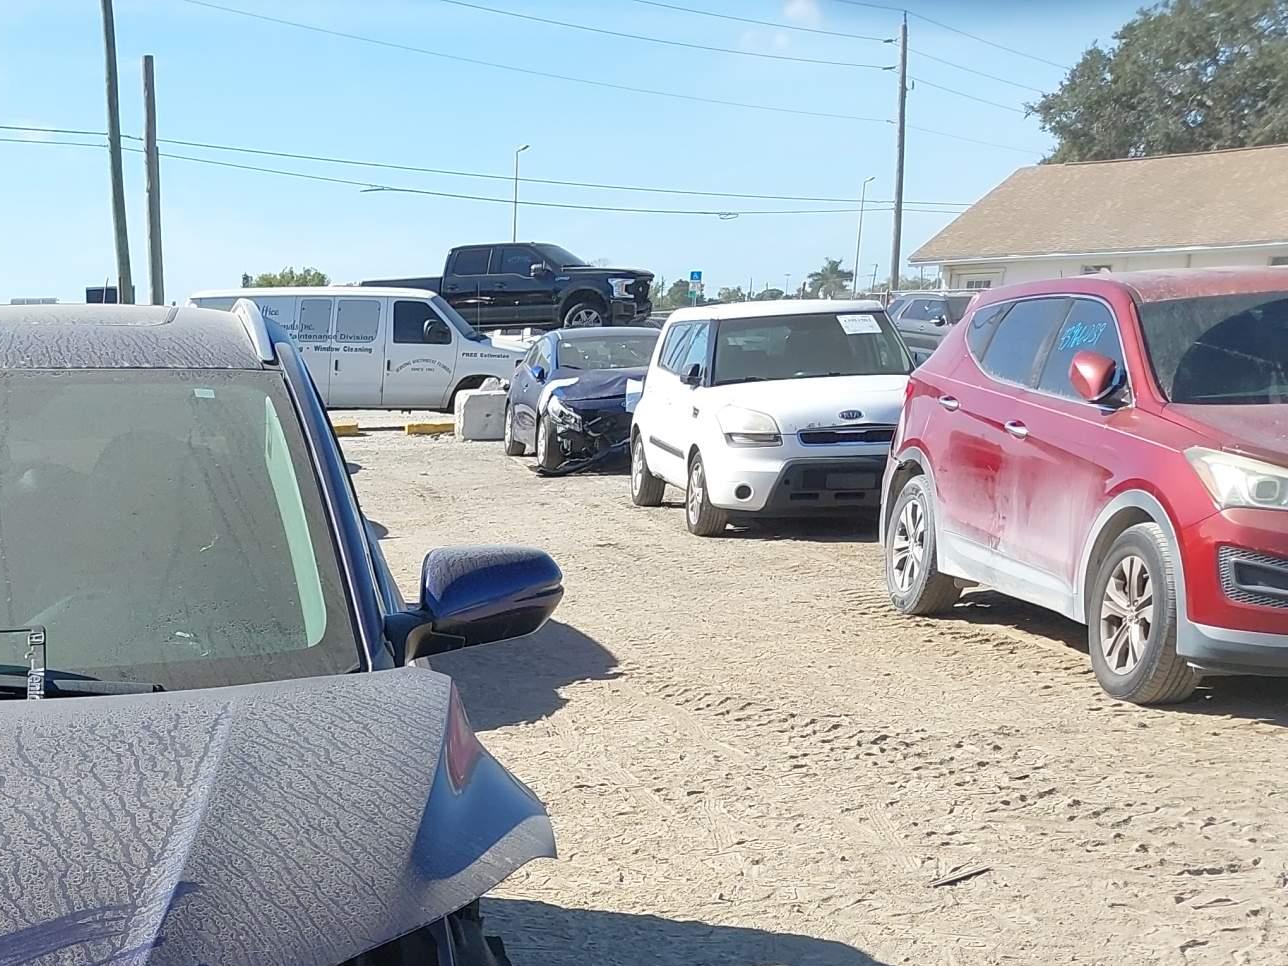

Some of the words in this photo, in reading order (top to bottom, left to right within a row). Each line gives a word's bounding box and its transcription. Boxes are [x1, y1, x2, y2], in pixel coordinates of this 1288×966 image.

[339, 333, 374, 341] Division
[313, 345, 340, 353] Window
[342, 345, 373, 354] Cleaning
